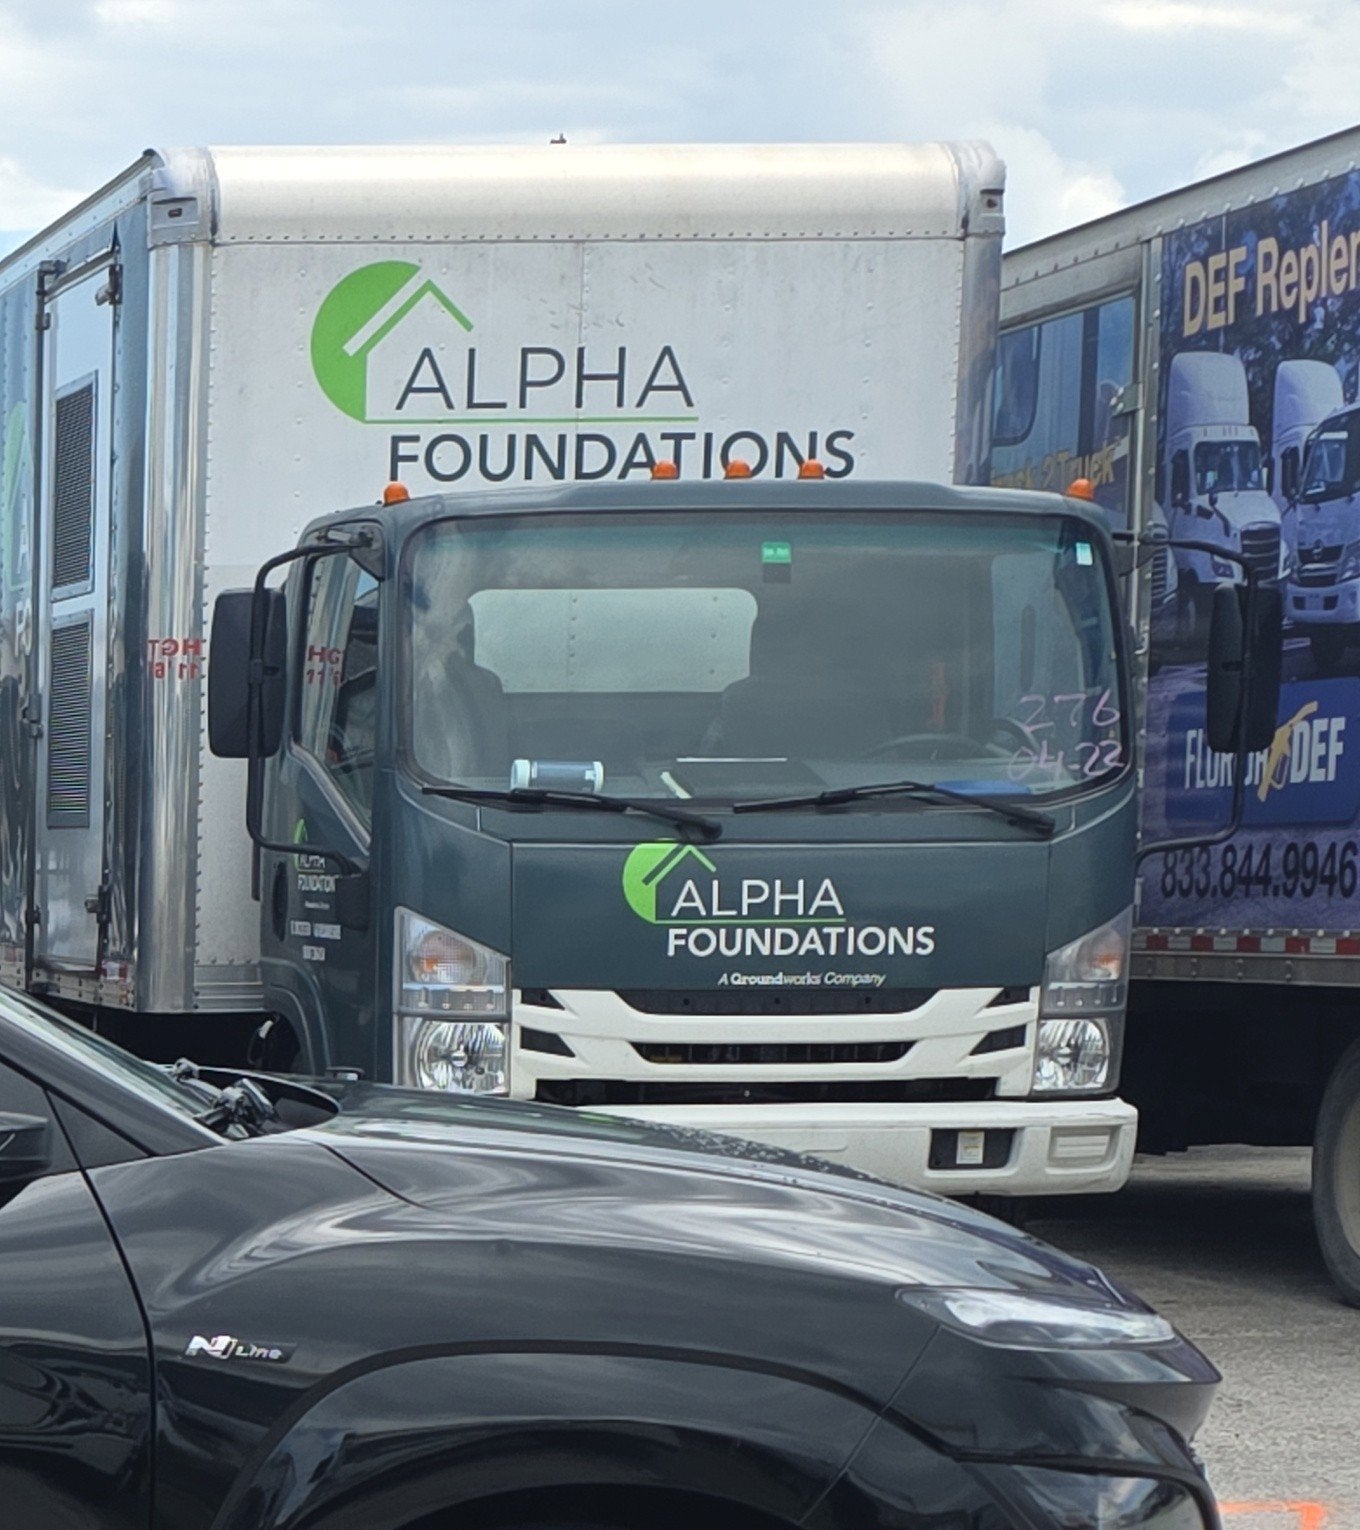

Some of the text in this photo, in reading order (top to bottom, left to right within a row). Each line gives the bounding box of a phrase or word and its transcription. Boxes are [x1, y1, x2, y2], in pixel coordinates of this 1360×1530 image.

[1182, 246, 1248, 338] DEF
[394, 345, 695, 411] ALPHA
[388, 429, 856, 483] FOUNDATIONS
[1020, 688, 1120, 731] 276
[1289, 716, 1346, 783] DEF
[1160, 840, 1358, 898] 833.844.9946
[670, 878, 844, 917] ALPHA
[667, 926, 936, 958] FOUNDATIONS
[717, 971, 887, 988] A Groundworks Company
